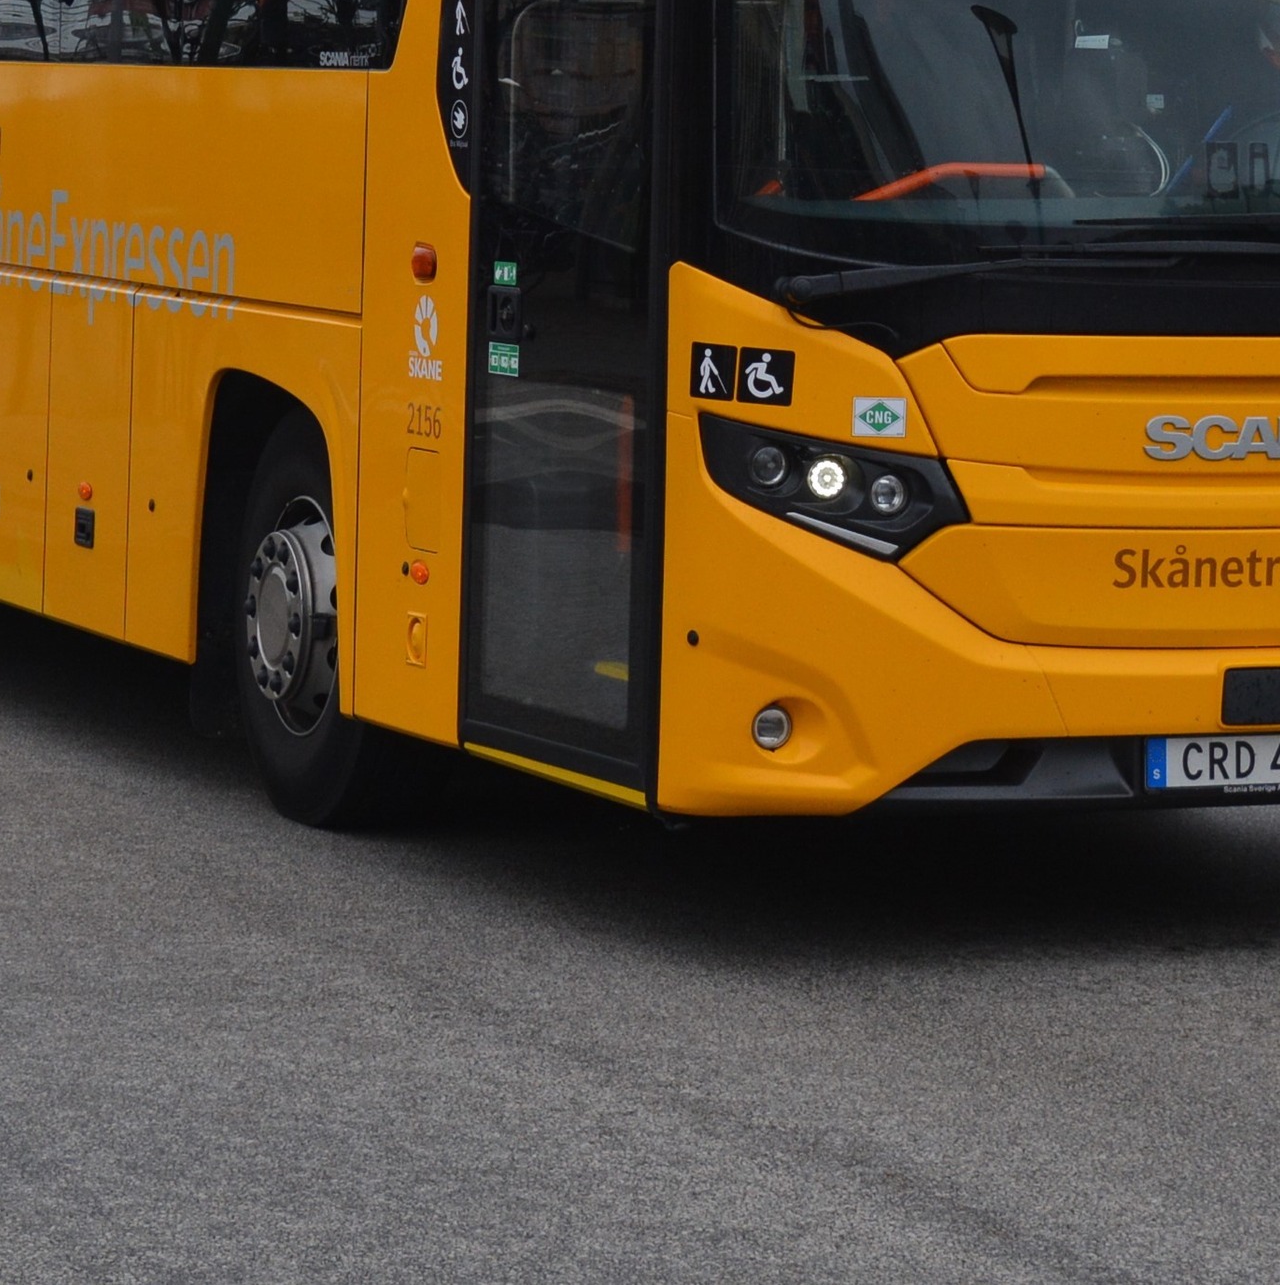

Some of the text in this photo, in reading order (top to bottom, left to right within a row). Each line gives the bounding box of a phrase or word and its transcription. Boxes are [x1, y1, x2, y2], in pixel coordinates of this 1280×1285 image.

[320, 52, 348, 66] SCANIA
[407, 402, 441, 438] 2156
[866, 410, 892, 424] CNG
[1182, 740, 1255, 781] CRD
[1153, 769, 1160, 780] S
